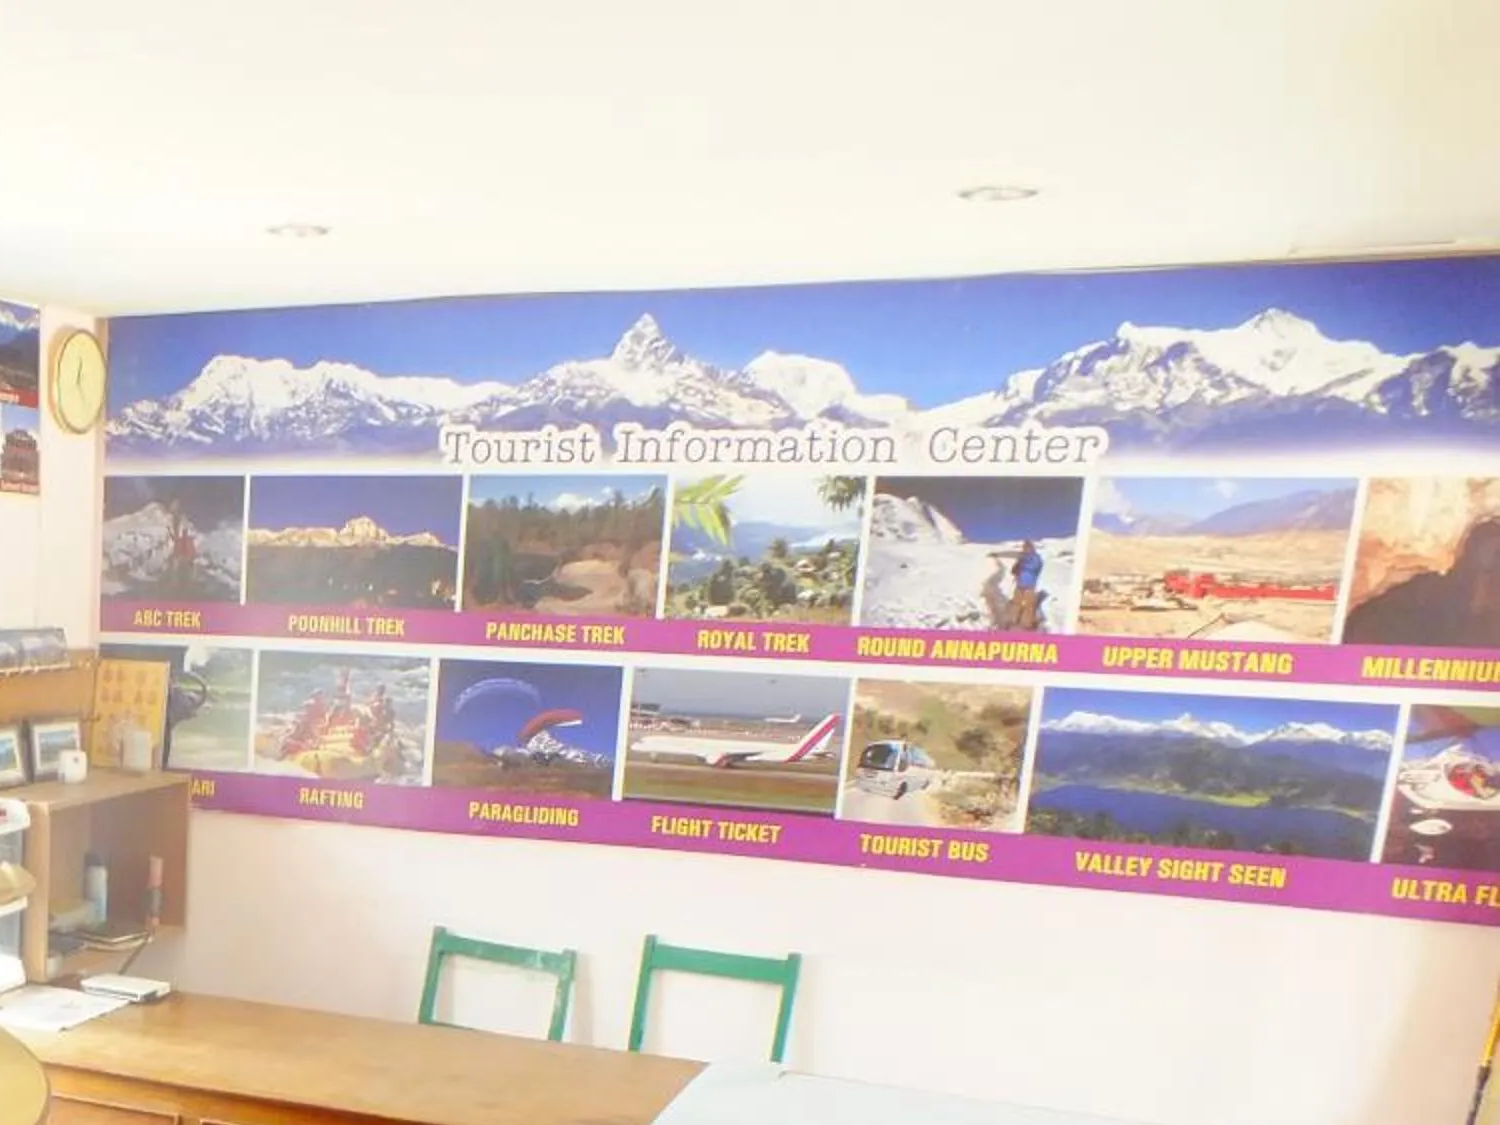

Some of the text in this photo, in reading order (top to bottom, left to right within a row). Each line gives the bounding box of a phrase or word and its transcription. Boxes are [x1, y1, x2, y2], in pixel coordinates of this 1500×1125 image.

[445, 427, 1100, 464] Tourist Information Center
[133, 609, 201, 628] ABC TREK
[288, 614, 405, 636] POONHILL TREK
[486, 622, 625, 645] PANCHASE TREK
[698, 629, 810, 653] ROYAL TREK
[857, 636, 1058, 664] ROUND ANNAPURNA
[1102, 646, 1294, 675] UPPER MUSTANG
[190, 778, 215, 798] ARI
[299, 787, 364, 810] RAFTING
[468, 801, 579, 827] PARAGLIDING
[651, 816, 782, 844] FLIGHT TICKET
[860, 833, 990, 863] TOURIST BUS
[1075, 851, 1287, 889] VALLEY SIGHT SEEN
[1392, 877, 1467, 904] ULTRA
